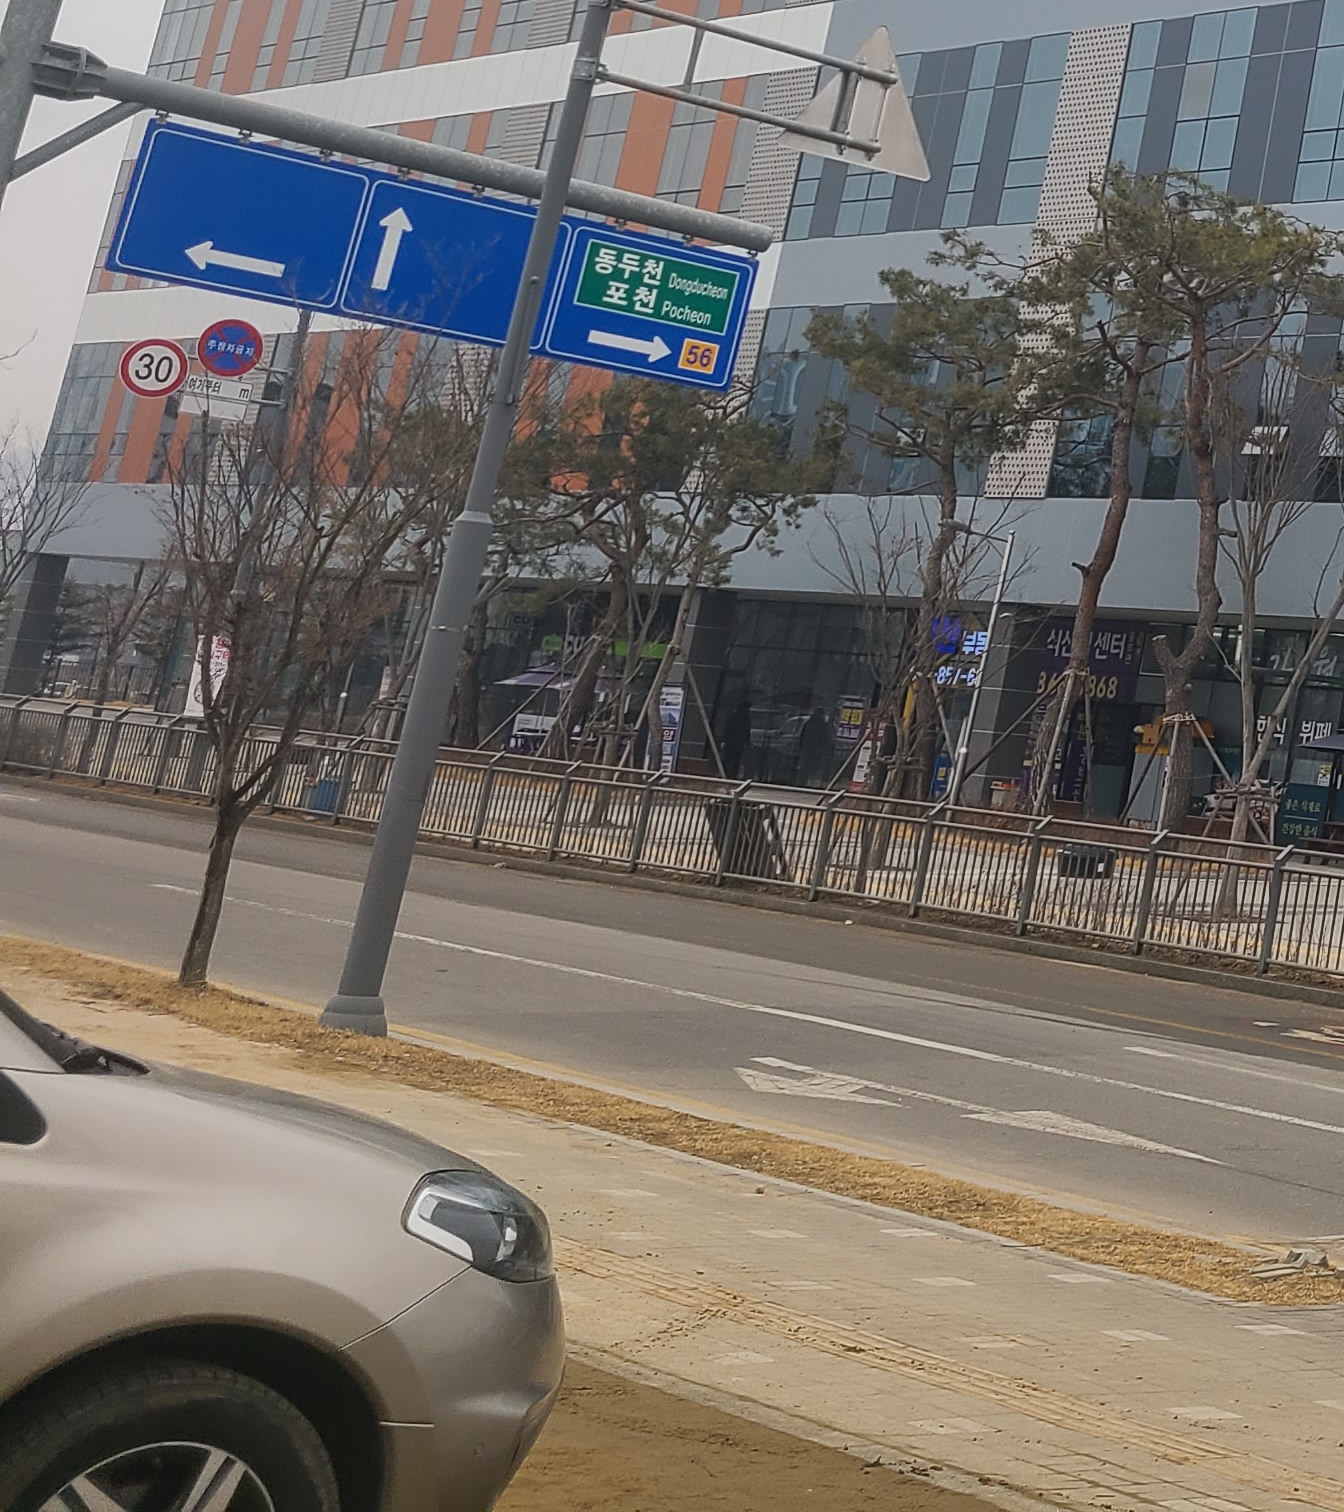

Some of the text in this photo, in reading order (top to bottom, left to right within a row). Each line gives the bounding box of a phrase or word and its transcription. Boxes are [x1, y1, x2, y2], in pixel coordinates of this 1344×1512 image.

[594, 247, 729, 301] 동두천 Dongducheon
[602, 280, 712, 326] 포천 Pocheon
[206, 338, 255, 357] 주정차금지
[685, 345, 713, 368] 56
[134, 352, 174, 384] 30
[188, 376, 222, 395] 여기부터
